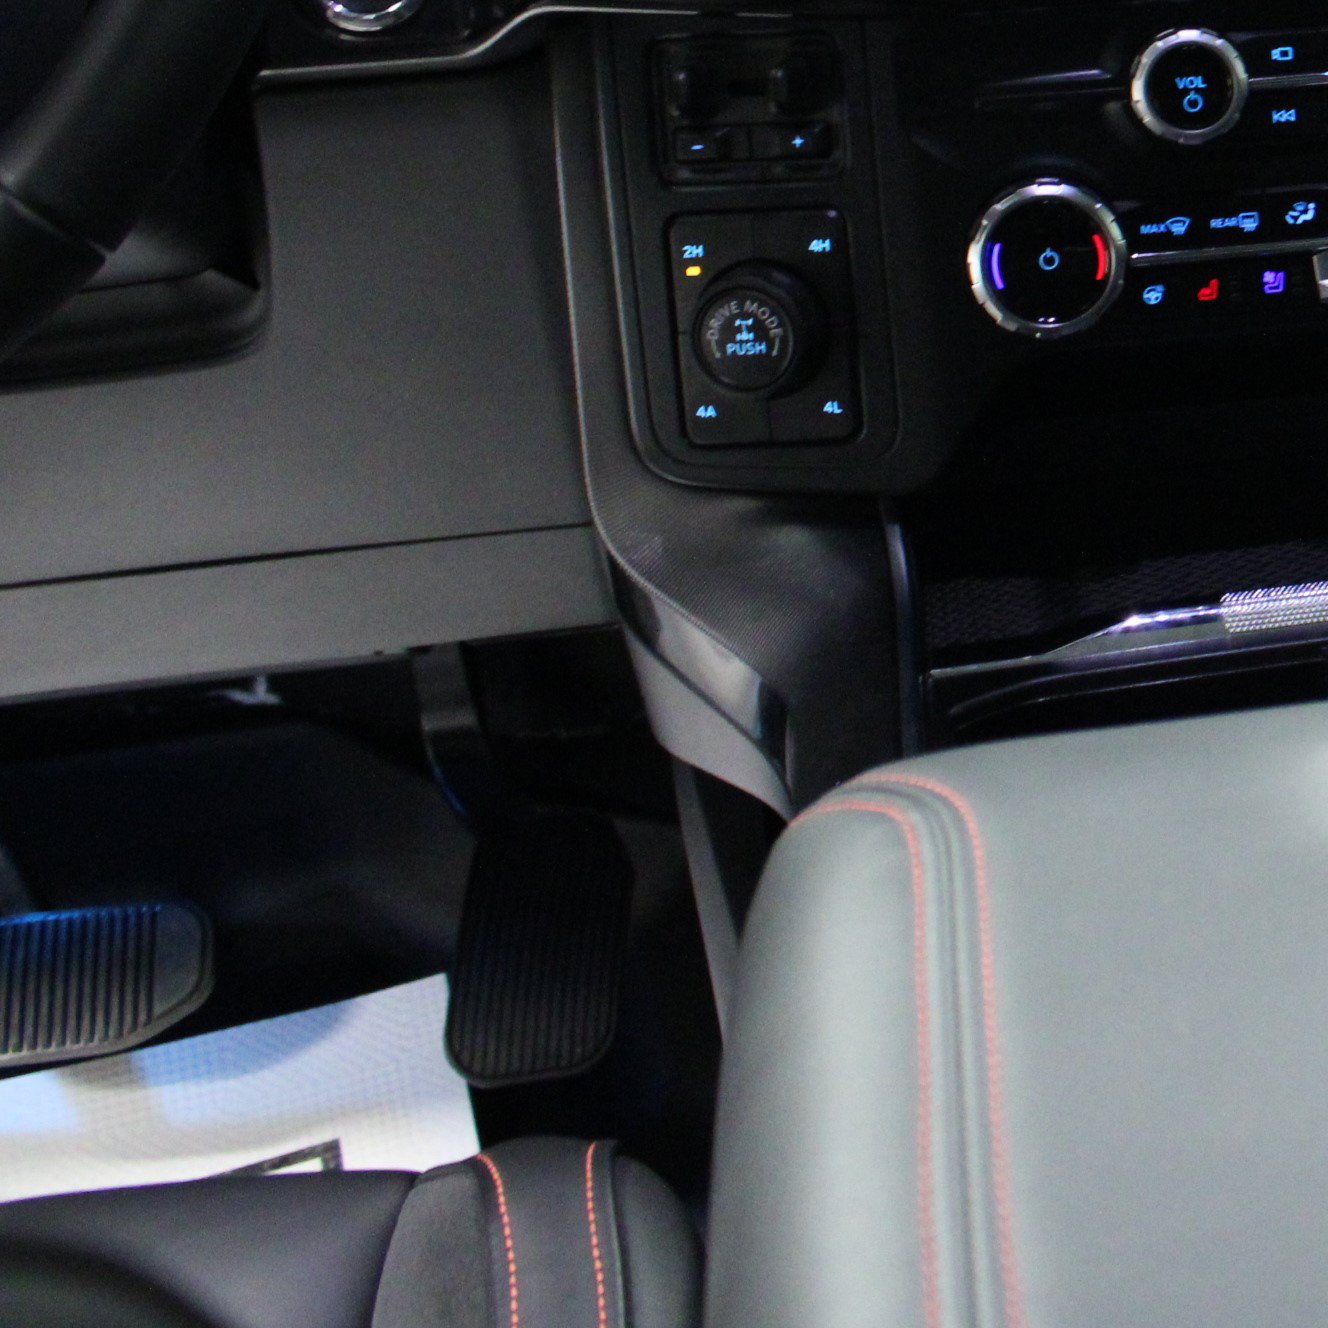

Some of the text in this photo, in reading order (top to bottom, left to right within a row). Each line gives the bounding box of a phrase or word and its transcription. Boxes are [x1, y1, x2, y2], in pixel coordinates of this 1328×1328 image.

[1175, 75, 1208, 90] VOL
[1139, 222, 1168, 235] MAX
[1209, 216, 1237, 229] REAR
[682, 244, 704, 259] 2H
[808, 238, 831, 253] 4H
[743, 299, 783, 338] MODE
[725, 341, 767, 357] PUSH
[696, 405, 717, 419] 4A
[823, 400, 843, 414] 4L
